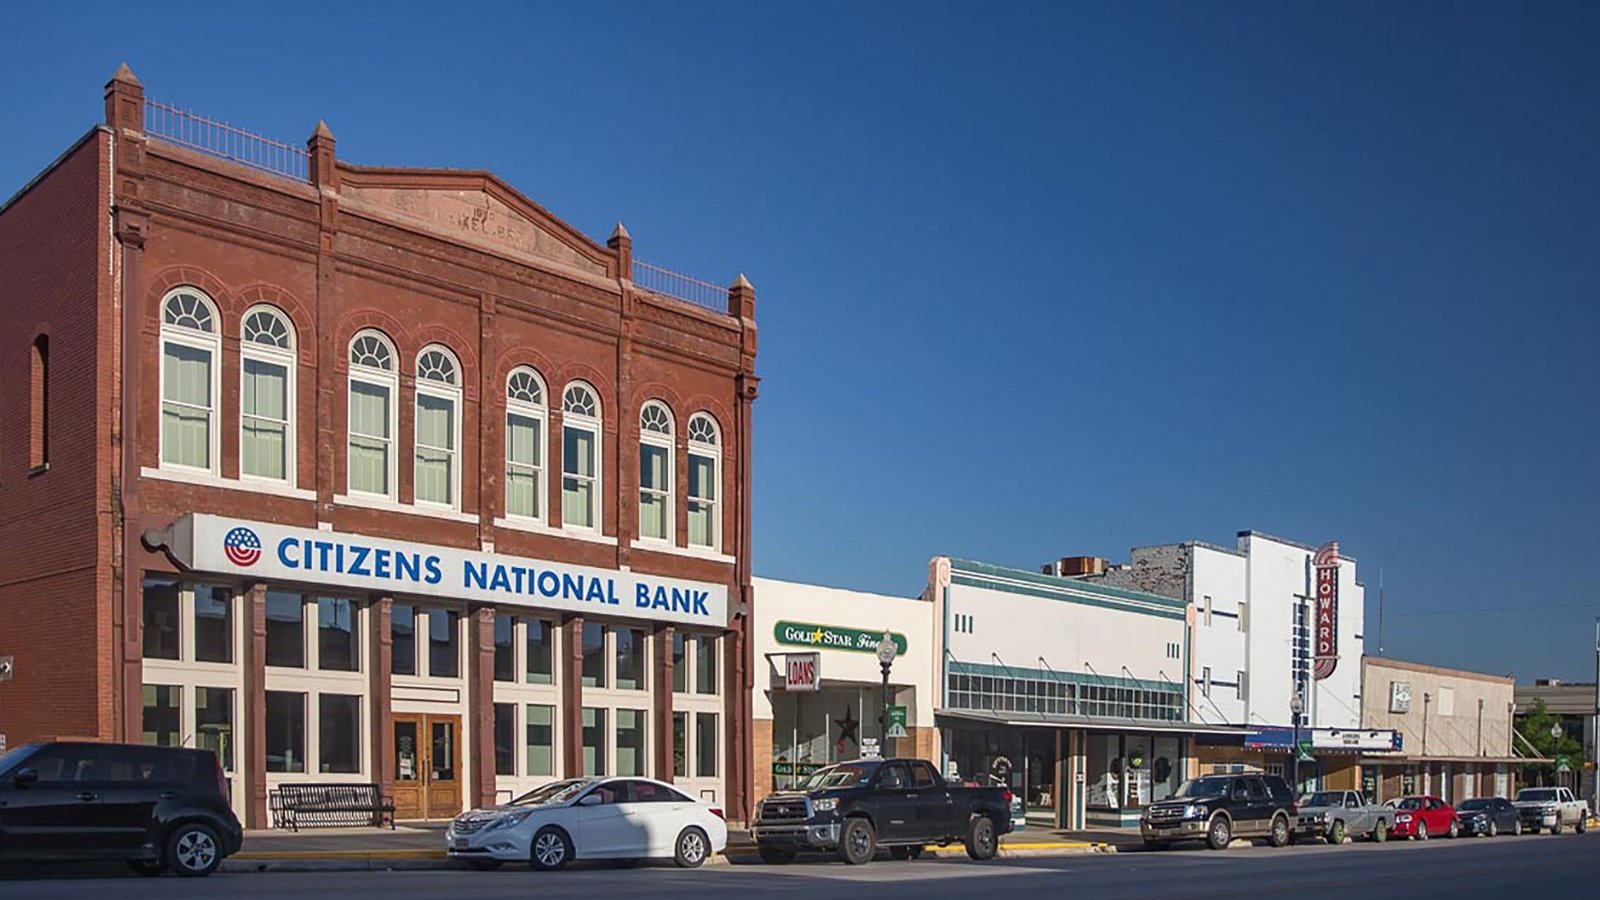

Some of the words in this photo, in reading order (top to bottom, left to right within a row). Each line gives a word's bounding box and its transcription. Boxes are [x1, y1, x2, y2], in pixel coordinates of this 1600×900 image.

[277, 537, 442, 584] CITIZENS
[464, 560, 619, 605] NATIONAL
[635, 583, 709, 616] BANK
[1319, 569, 1331, 653] HOWARD
[824, 631, 852, 646] STAR
[788, 661, 814, 684] LOANS
